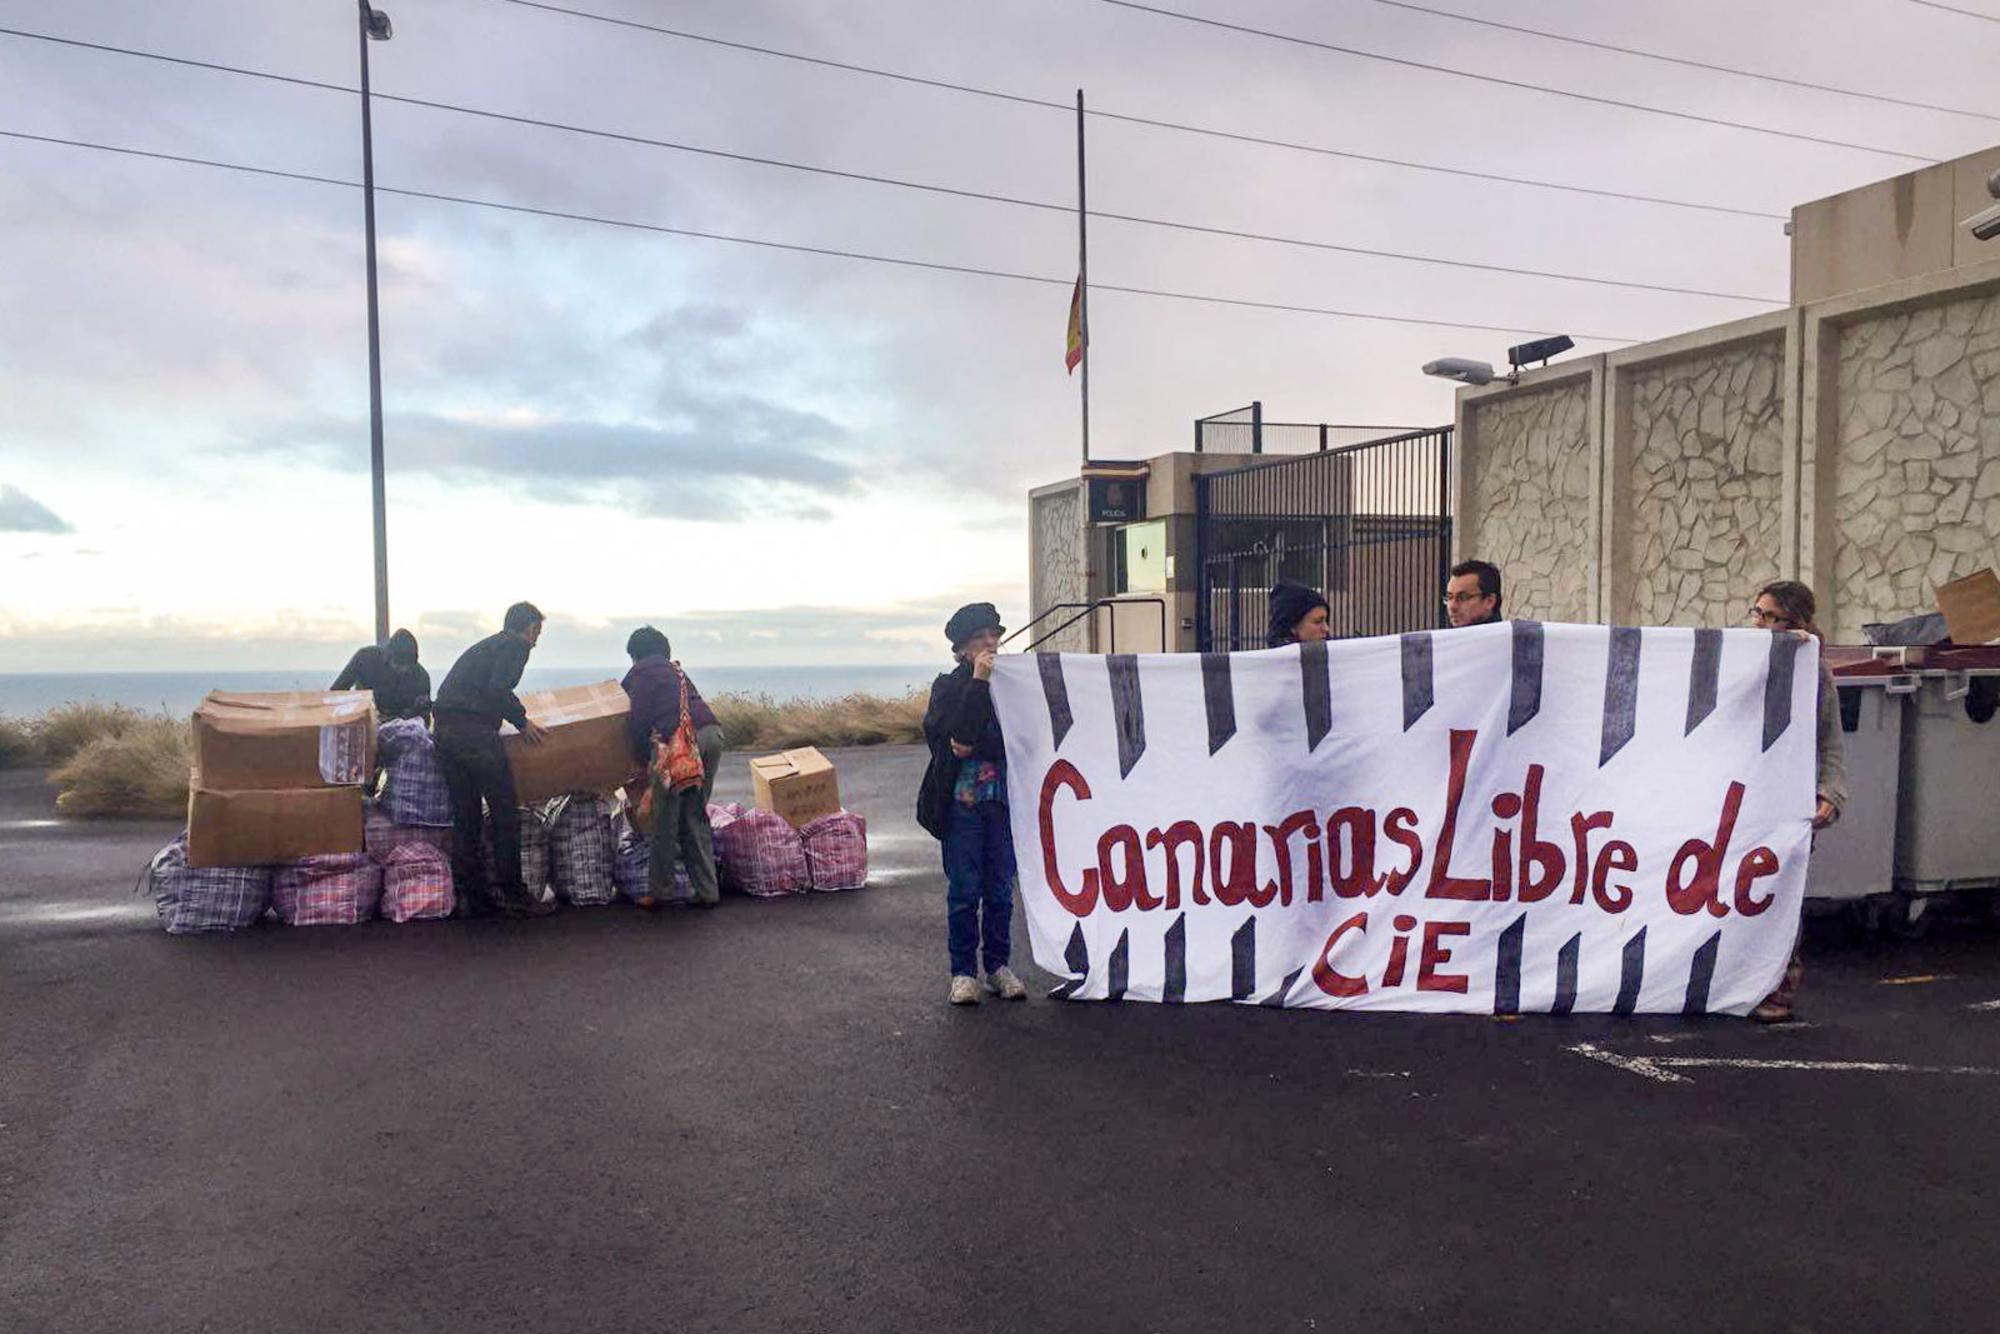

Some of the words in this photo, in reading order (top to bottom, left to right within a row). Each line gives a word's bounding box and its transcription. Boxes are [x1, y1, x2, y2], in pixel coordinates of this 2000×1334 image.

[1039, 758, 1423, 917] Canarias
[1426, 729, 1638, 914] Libre
[1665, 781, 1779, 917] de
